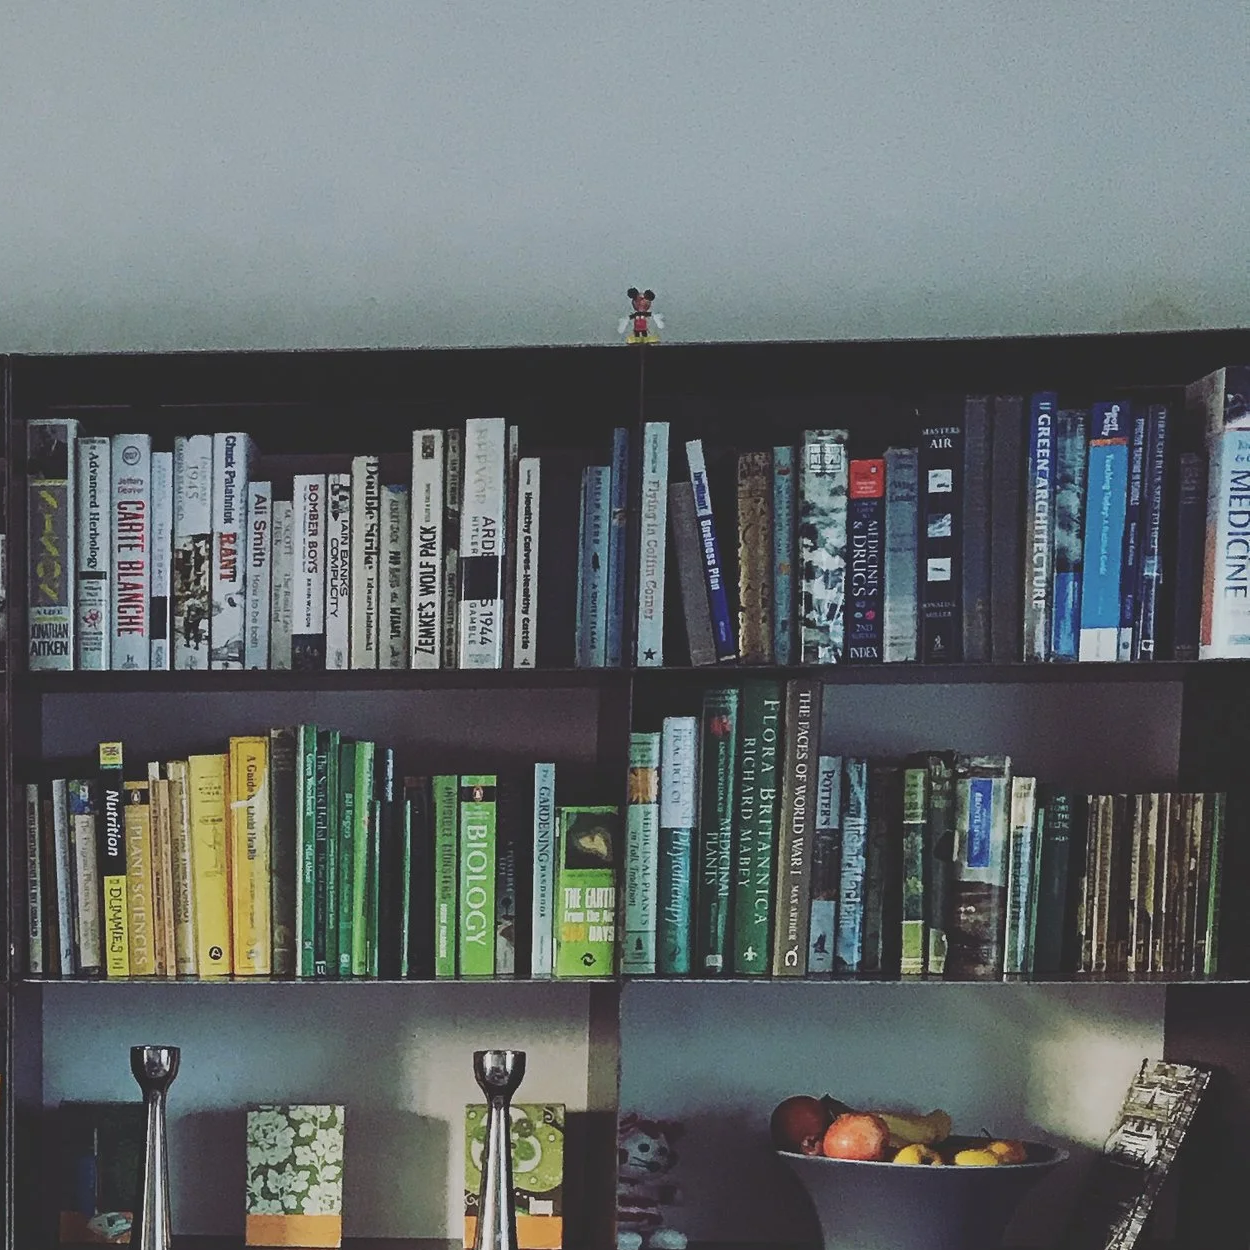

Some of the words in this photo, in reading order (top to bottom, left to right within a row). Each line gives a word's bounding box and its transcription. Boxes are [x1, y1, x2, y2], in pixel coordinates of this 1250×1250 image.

[1101, 411, 1113, 437] Petty
[1109, 404, 1120, 432] Geoff
[225, 435, 237, 468] Chuck
[929, 437, 953, 449] AIR
[1036, 412, 1051, 477] GREEN
[89, 451, 100, 508] Advanced
[187, 464, 198, 499] 1945
[364, 461, 378, 520] Double
[1102, 454, 1114, 490] Teaching
[224, 470, 237, 524] Palahniuk
[254, 493, 267, 515] Ali
[307, 483, 319, 537] BOMBER
[522, 491, 533, 534] Healthy
[646, 479, 661, 521] Flying
[86, 511, 100, 570] Herbology
[117, 500, 145, 553] CARTE
[253, 520, 266, 568] Smith
[340, 519, 348, 546] IAIN
[419, 525, 437, 557] PACK
[648, 523, 660, 535] in
[700, 519, 717, 566] Business
[852, 521, 863, 530] &
[1032, 477, 1050, 610] ARCHITECTURE
[1225, 470, 1250, 598] MEDICINE
[220, 532, 237, 583] RANT
[307, 540, 319, 574] BOYS
[330, 537, 339, 618] COMPLICITY
[340, 549, 349, 597] BANKS
[645, 539, 659, 577] Coffin
[852, 535, 867, 596] DRUGS
[867, 520, 878, 596] MEDICINES
[117, 560, 145, 637] BLANCHE
[251, 574, 260, 595] How
[418, 561, 436, 597] WOLF
[707, 567, 721, 590] Plan
[251, 598, 259, 609] to
[251, 611, 259, 623] be
[644, 580, 658, 621] Corner
[30, 623, 68, 639] JONATHAN
[251, 625, 259, 648] both
[414, 601, 435, 656] ZEMKE'S
[468, 602, 478, 645] GAMBLE
[479, 611, 493, 646] 1944
[521, 617, 530, 650] Cattle
[30, 641, 68, 656] AITKEN
[850, 646, 878, 658] INDEX
[798, 690, 812, 718] THE
[760, 700, 780, 773] FLORA
[795, 720, 810, 760] FACES
[246, 755, 257, 763] A
[246, 764, 257, 792] Guide
[305, 752, 316, 777] Green
[316, 754, 327, 772] The
[740, 738, 757, 820] RICHARD
[795, 763, 809, 782] OF
[792, 785, 808, 834] WORLD
[819, 769, 836, 827] POTTER'S
[105, 790, 121, 857] Nutrition
[316, 806, 327, 841] Herbal
[538, 786, 550, 864] GARDENING
[641, 810, 653, 873] MEDICINAL
[129, 825, 143, 878] PLANT
[704, 832, 718, 885] PLANTS
[717, 818, 731, 897] MEDICINAL
[737, 828, 753, 888] MABEY
[753, 787, 777, 925] BRITANNICA
[790, 837, 805, 867] WAR
[465, 824, 488, 946] BIOLOGY
[564, 887, 582, 908] THE
[585, 887, 615, 908] EARTH
[665, 830, 689, 927] Phytotherapy
[790, 885, 800, 904] MAX
[109, 887, 124, 953] DUMMIES
[564, 910, 584, 923] from
[587, 910, 600, 922] the
[641, 875, 652, 927] PLANTS
[131, 883, 148, 965] SCIENCES
[588, 925, 615, 942] DAYS
[788, 907, 798, 941] ARTHUR
